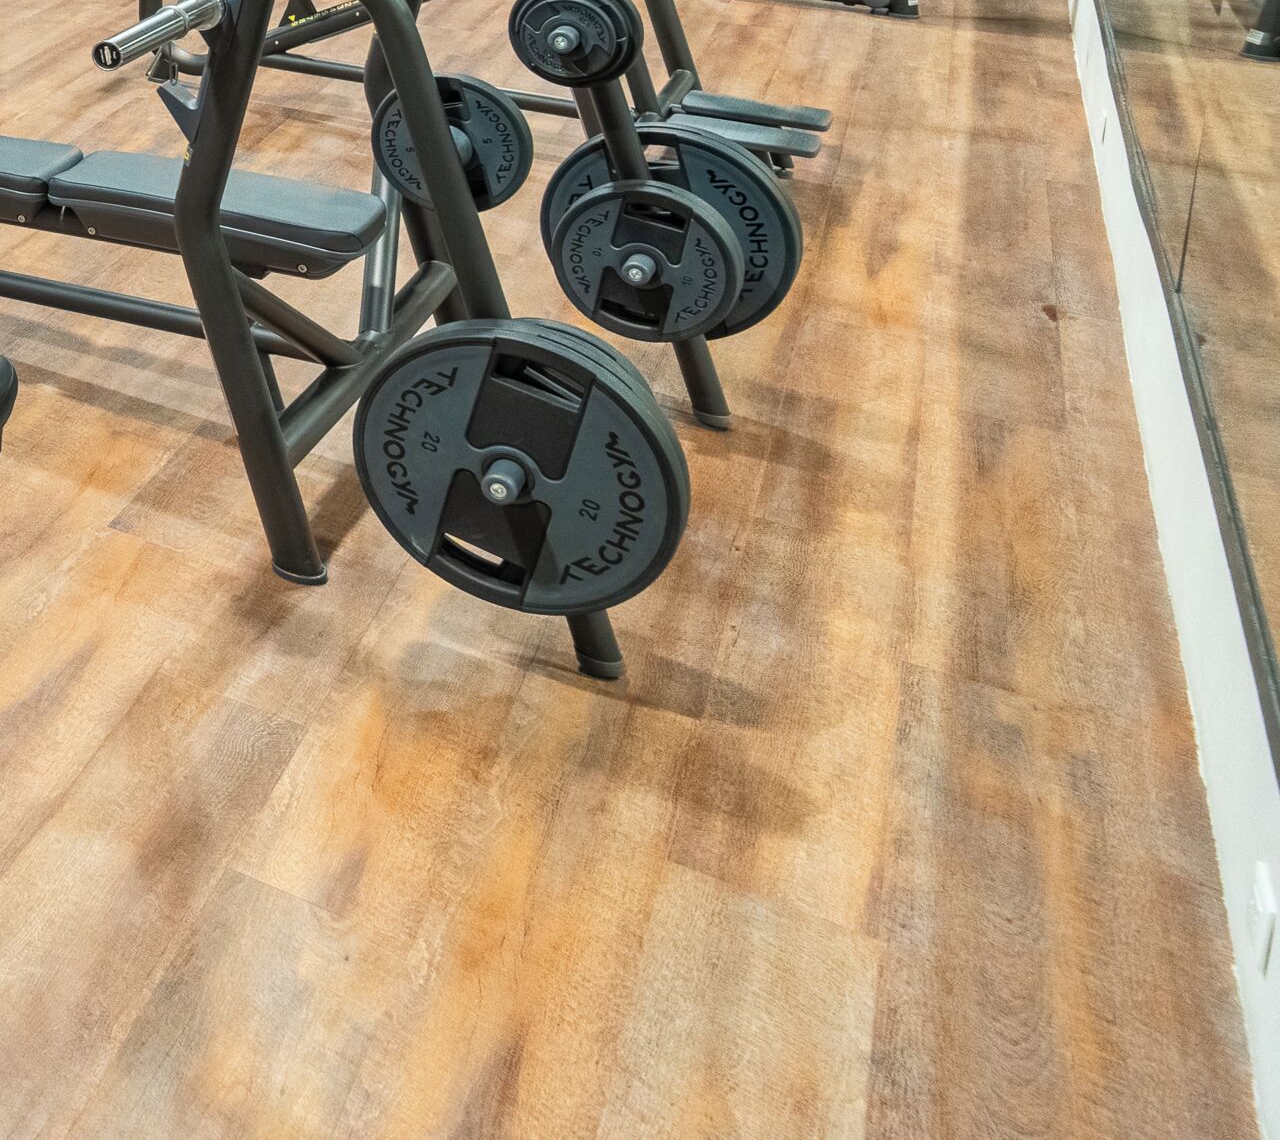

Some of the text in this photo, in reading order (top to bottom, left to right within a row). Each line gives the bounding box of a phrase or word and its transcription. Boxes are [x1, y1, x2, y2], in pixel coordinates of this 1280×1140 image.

[384, 108, 422, 191] TECHNOGYM
[475, 99, 515, 184] TECHNOGYM
[569, 210, 611, 294] TECHNOGYM
[592, 246, 603, 258] 10
[675, 238, 718, 324] TECHNOGYM
[682, 276, 694, 287] 10
[382, 366, 460, 516] TECHNOGYM
[421, 430, 441, 453] 20
[558, 431, 646, 586] TECHNOGYM
[578, 498, 600, 523] 20
